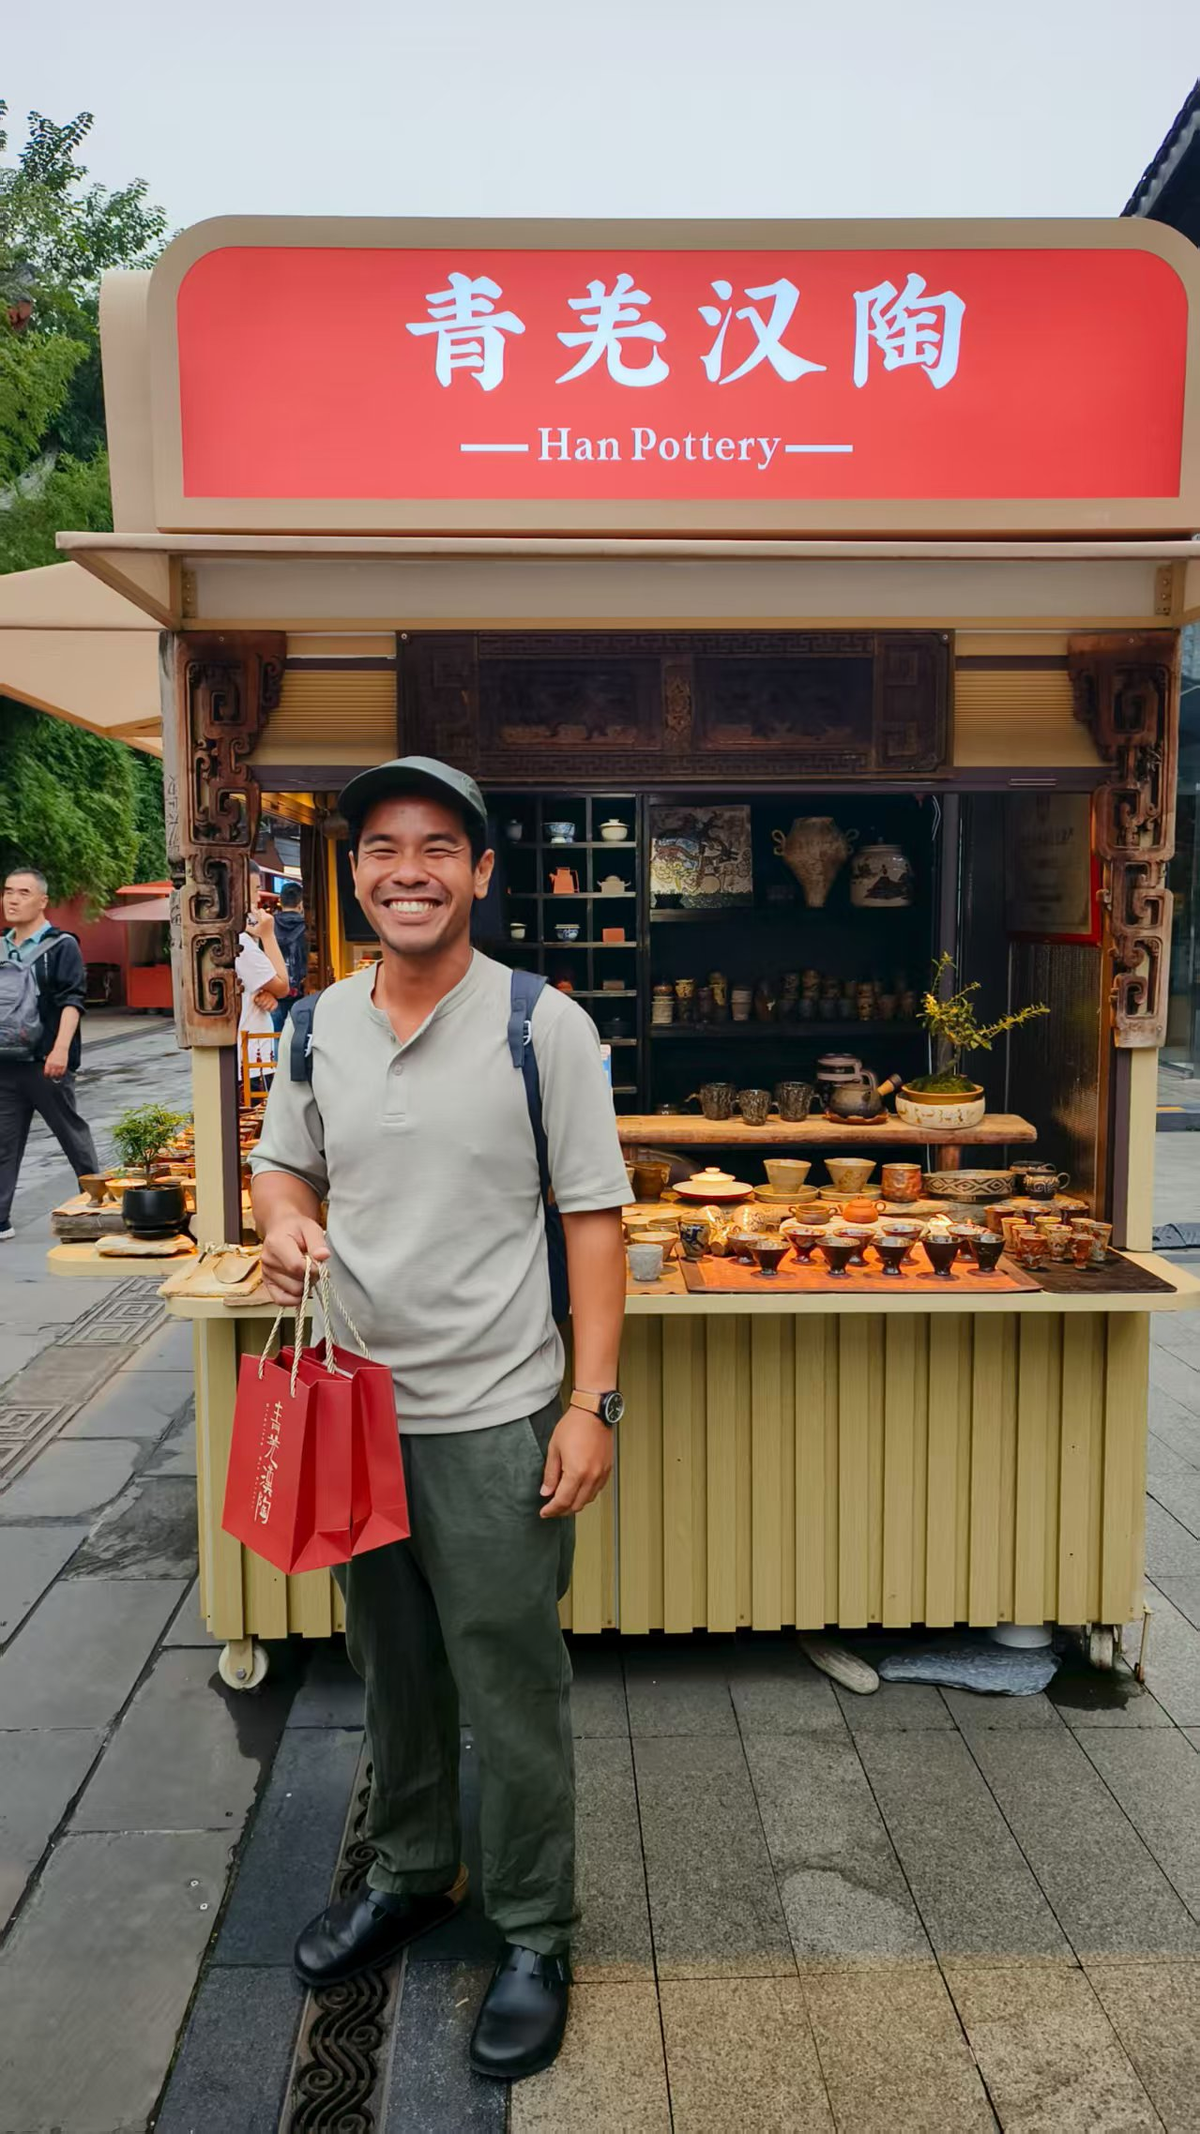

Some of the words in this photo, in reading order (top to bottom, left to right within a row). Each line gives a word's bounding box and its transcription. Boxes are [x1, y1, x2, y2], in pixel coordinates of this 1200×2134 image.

[405, 272, 966, 391] 青羌汉陶
[537, 427, 622, 462] Han
[631, 427, 781, 470] Pottery
